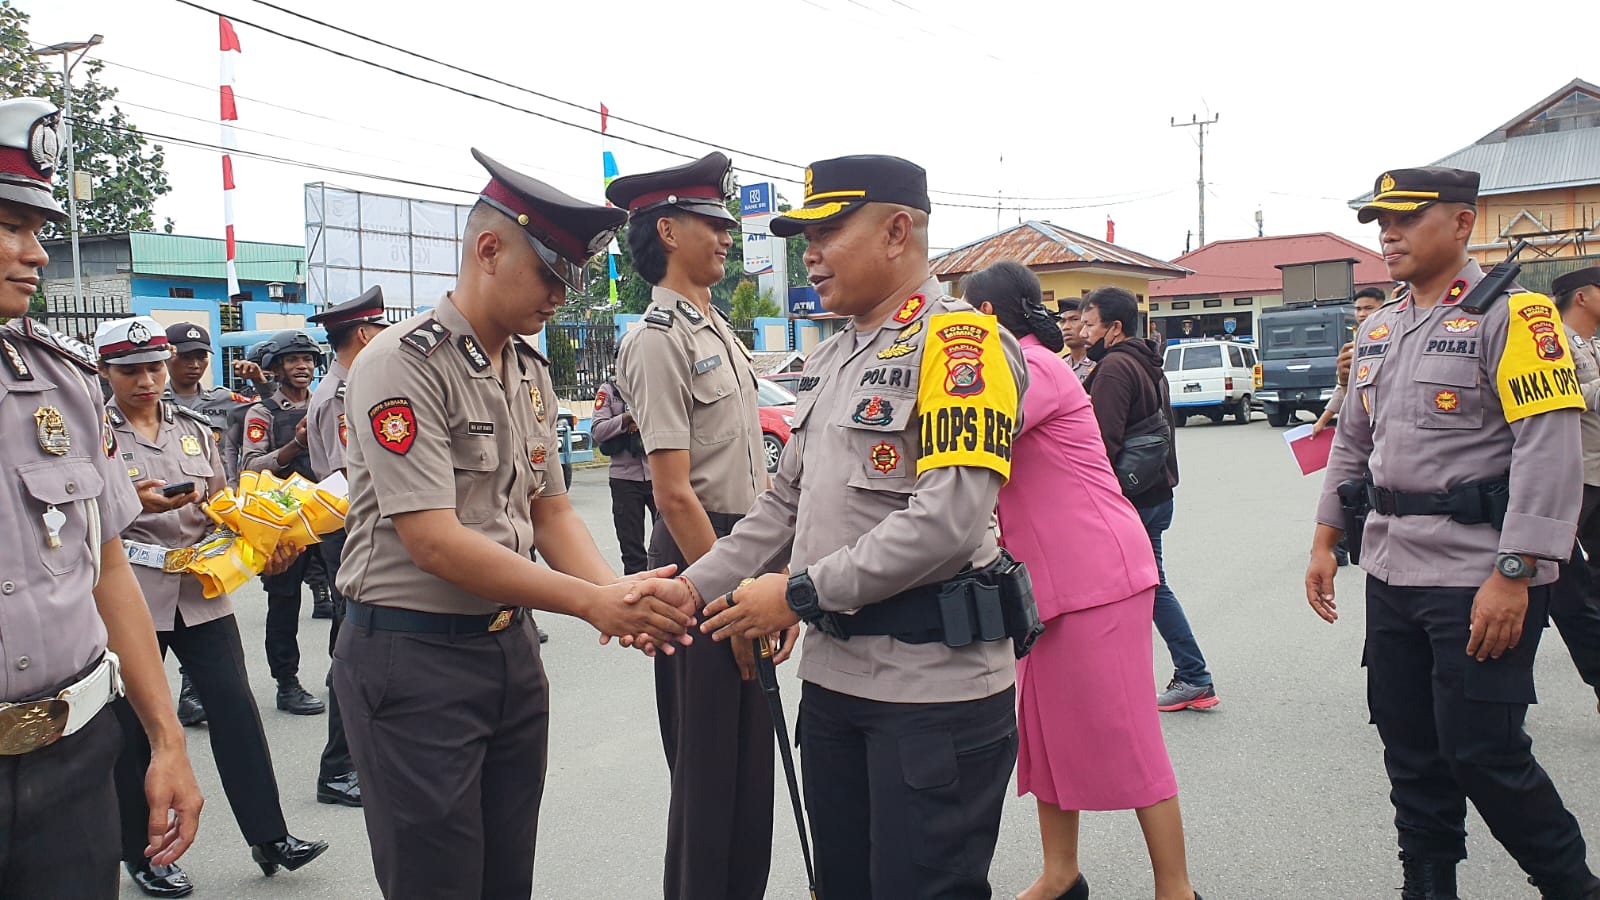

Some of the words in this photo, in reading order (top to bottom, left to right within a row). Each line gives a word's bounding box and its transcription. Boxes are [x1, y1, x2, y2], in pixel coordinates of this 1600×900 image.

[747, 232, 767, 242] ATM
[792, 301, 815, 312] ATM
[943, 325, 982, 334] POLRES
[945, 330, 981, 339] MIMIKA
[948, 344, 979, 353] PAPUA
[1426, 339, 1477, 354] POLRI
[860, 367, 912, 388] POLRI
[1508, 370, 1554, 406] WAKA
[1553, 367, 1578, 395] OPS
[202, 408, 227, 416] POLRI
[936, 406, 978, 453] OPS
[983, 407, 1012, 462] RES
